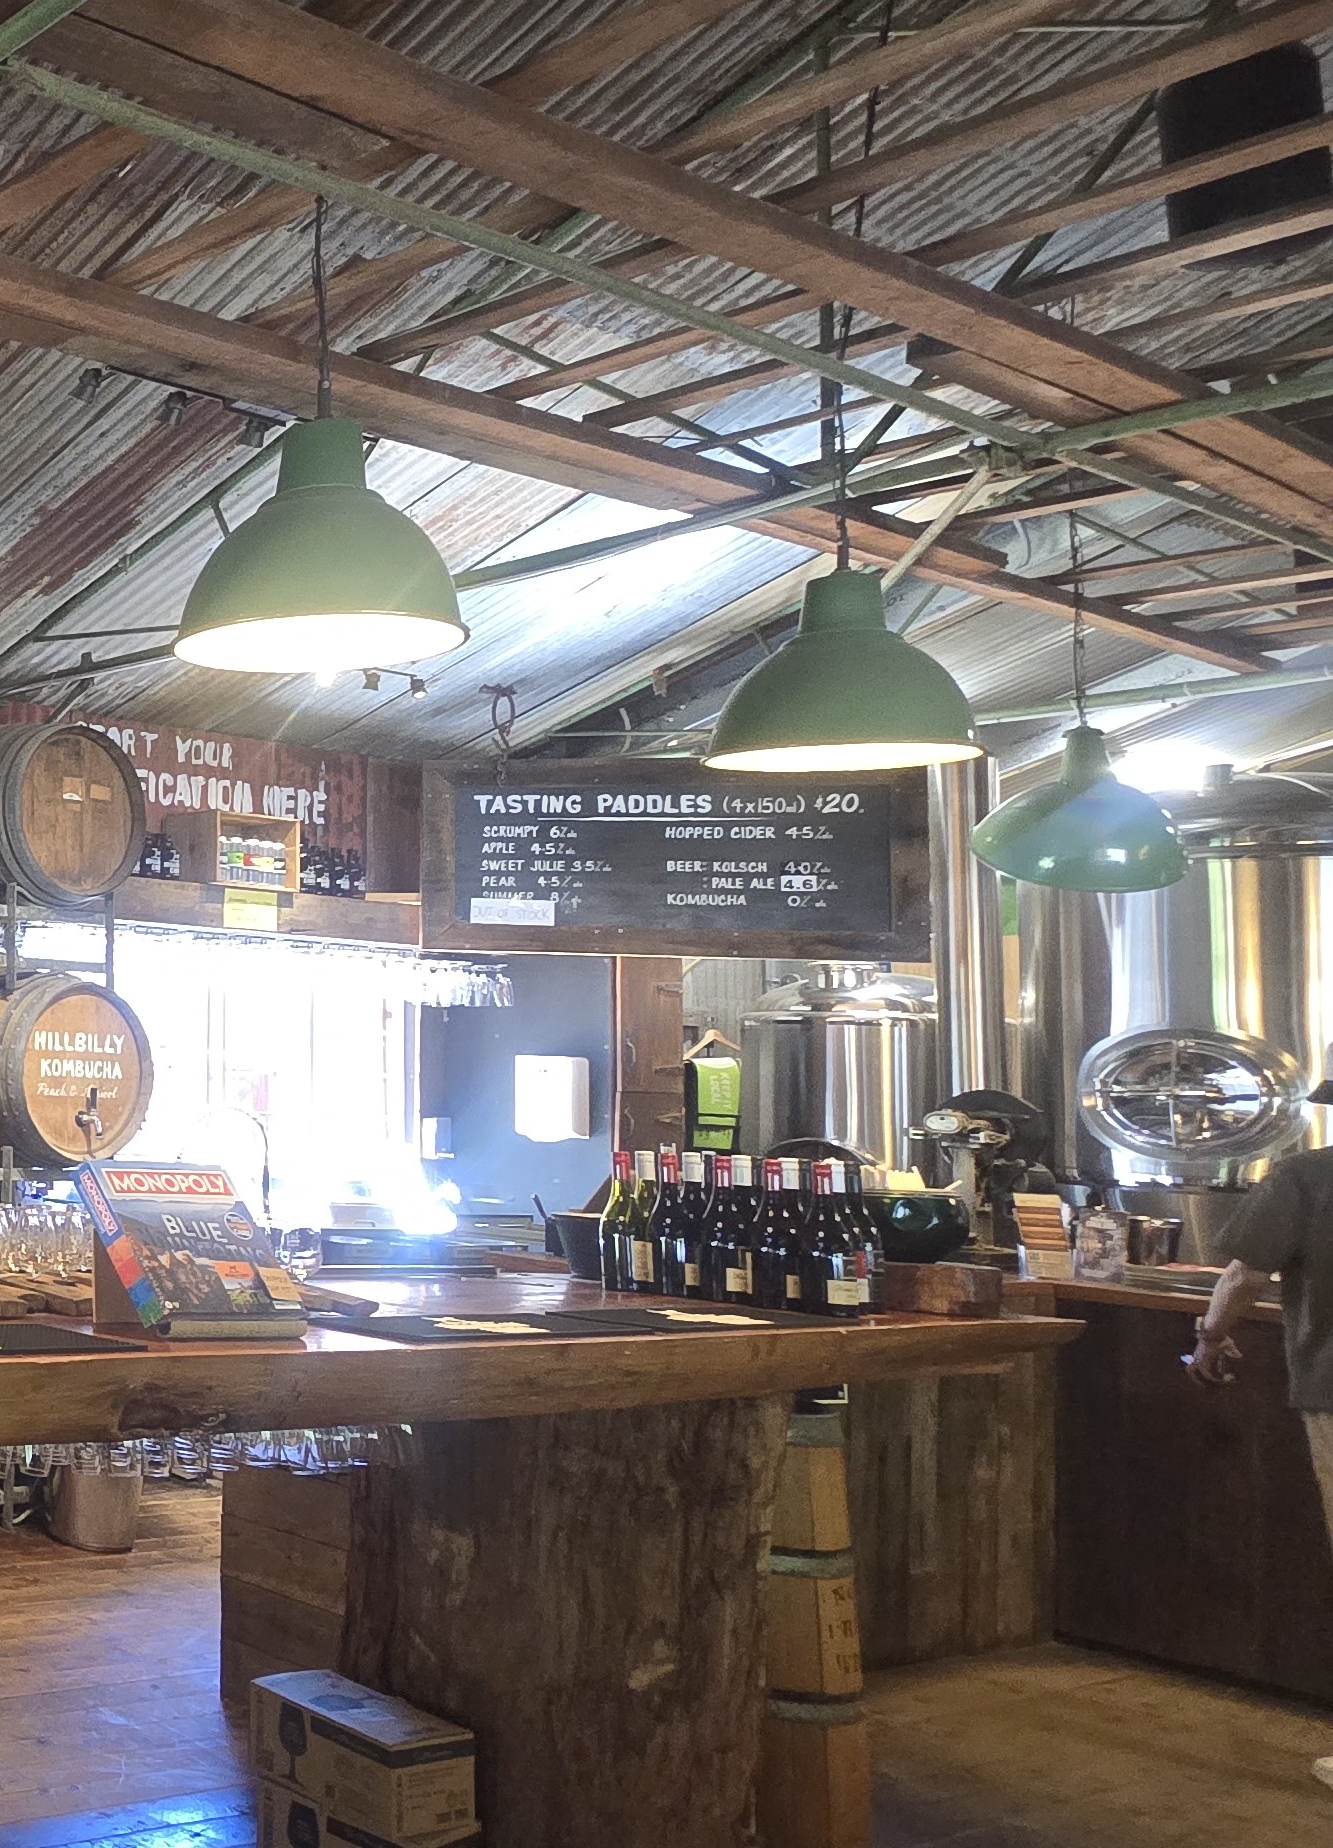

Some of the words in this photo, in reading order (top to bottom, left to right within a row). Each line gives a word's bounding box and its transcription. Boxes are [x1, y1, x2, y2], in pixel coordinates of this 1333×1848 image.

[176, 734, 233, 770] YOUR
[263, 784, 327, 825] HERE
[473, 794, 582, 814] TASTING
[597, 793, 712, 814] PADDLES
[482, 825, 539, 838] SCRUMPY
[665, 826, 724, 839] HOPPED
[730, 826, 776, 839] CIDER
[482, 842, 515, 854] APPLE
[480, 859, 525, 871] SWEET
[530, 860, 566, 871] JULIE
[712, 861, 768, 873] KOLSCH
[481, 876, 516, 887] PEAR
[711, 877, 744, 889] PALE
[750, 878, 775, 889] ALE
[666, 894, 747, 906] KOMBUCHA
[34, 1030, 125, 1055] HILLBILLY
[40, 1058, 123, 1080] KOMBUCHA
[110, 1172, 227, 1193] MONOPOLY
[82, 1174, 115, 1230] MONOPOLY
[161, 1213, 228, 1243] BLUE
